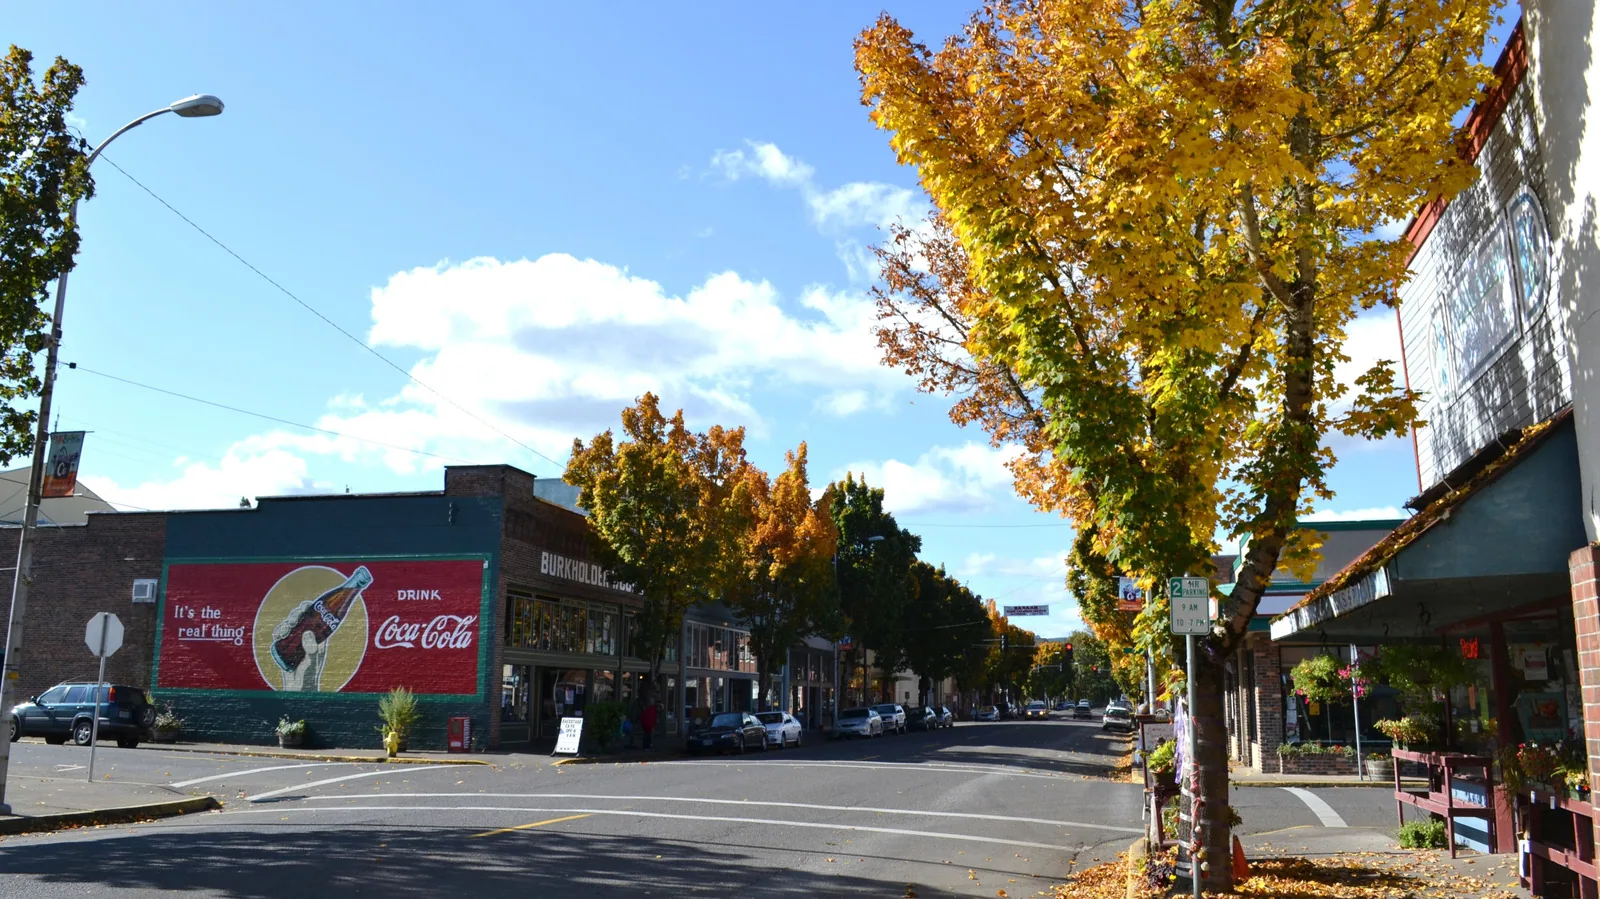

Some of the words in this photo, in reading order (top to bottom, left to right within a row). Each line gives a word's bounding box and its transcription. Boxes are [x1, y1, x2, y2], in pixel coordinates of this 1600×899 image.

[397, 589, 442, 601] DRINK
[1172, 581, 1181, 596] 2
[1189, 580, 1200, 588] HR
[174, 605, 195, 618] It's
[201, 605, 221, 619] the
[1181, 603, 1186, 611] 9
[1189, 603, 1198, 611] AM
[1176, 619, 1185, 627] TO
[1196, 619, 1205, 627] PM
[178, 623, 207, 638] real
[211, 623, 246, 646] thing
[374, 615, 478, 649] Coca-Cola
